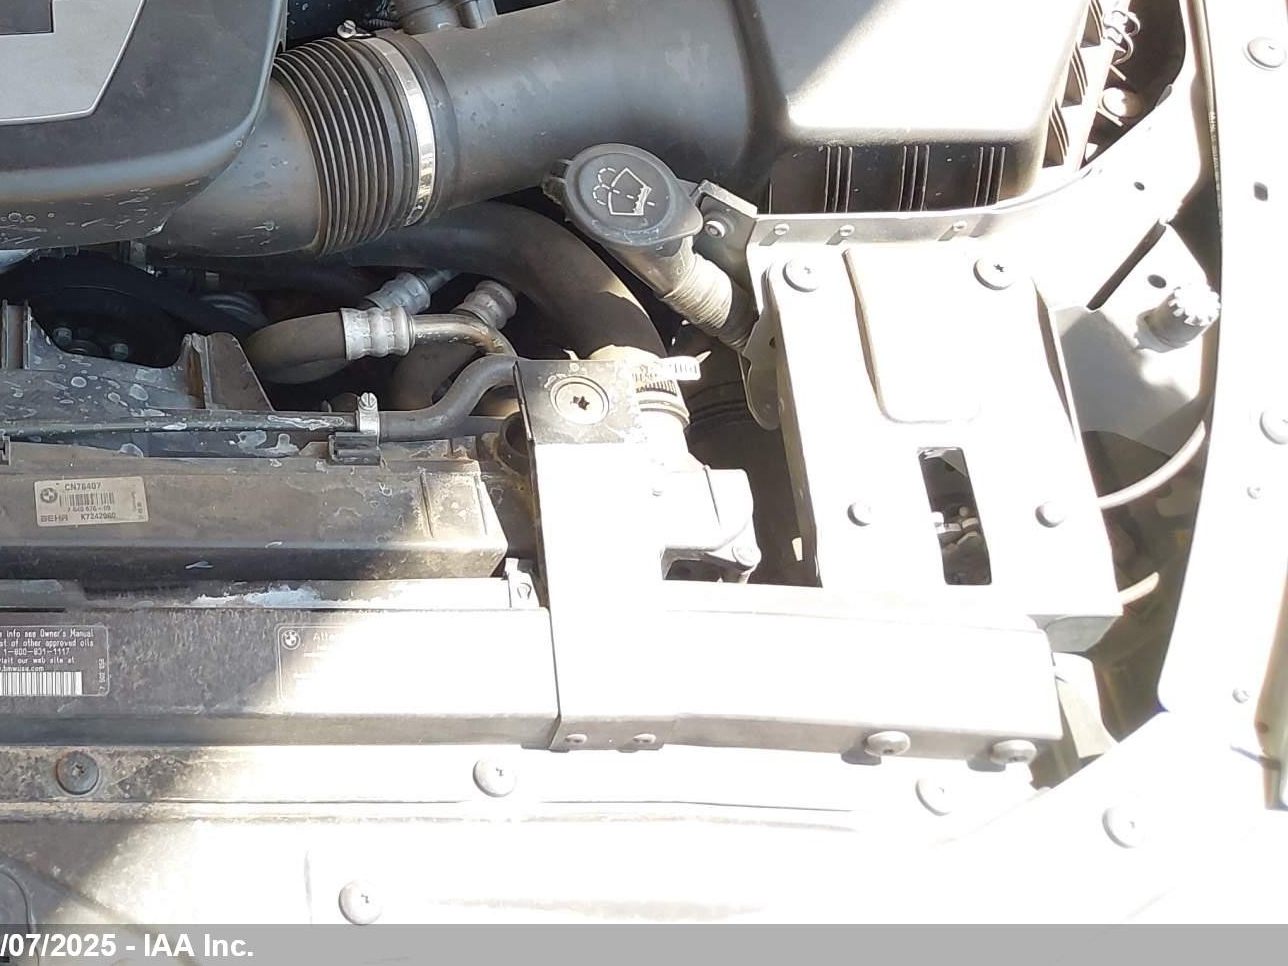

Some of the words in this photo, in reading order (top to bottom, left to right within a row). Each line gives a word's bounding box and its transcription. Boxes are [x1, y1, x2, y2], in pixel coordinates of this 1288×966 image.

[6, 628, 21, 638] info
[40, 628, 66, 637] Owner's
[70, 628, 94, 637] Manual
[11, 638, 19, 647] of
[23, 638, 41, 647] other
[45, 638, 76, 648] approved
[80, 638, 94, 647] oils
[3, 647, 70, 656] 1-800-831-1117
[50, 656, 63, 664] site
